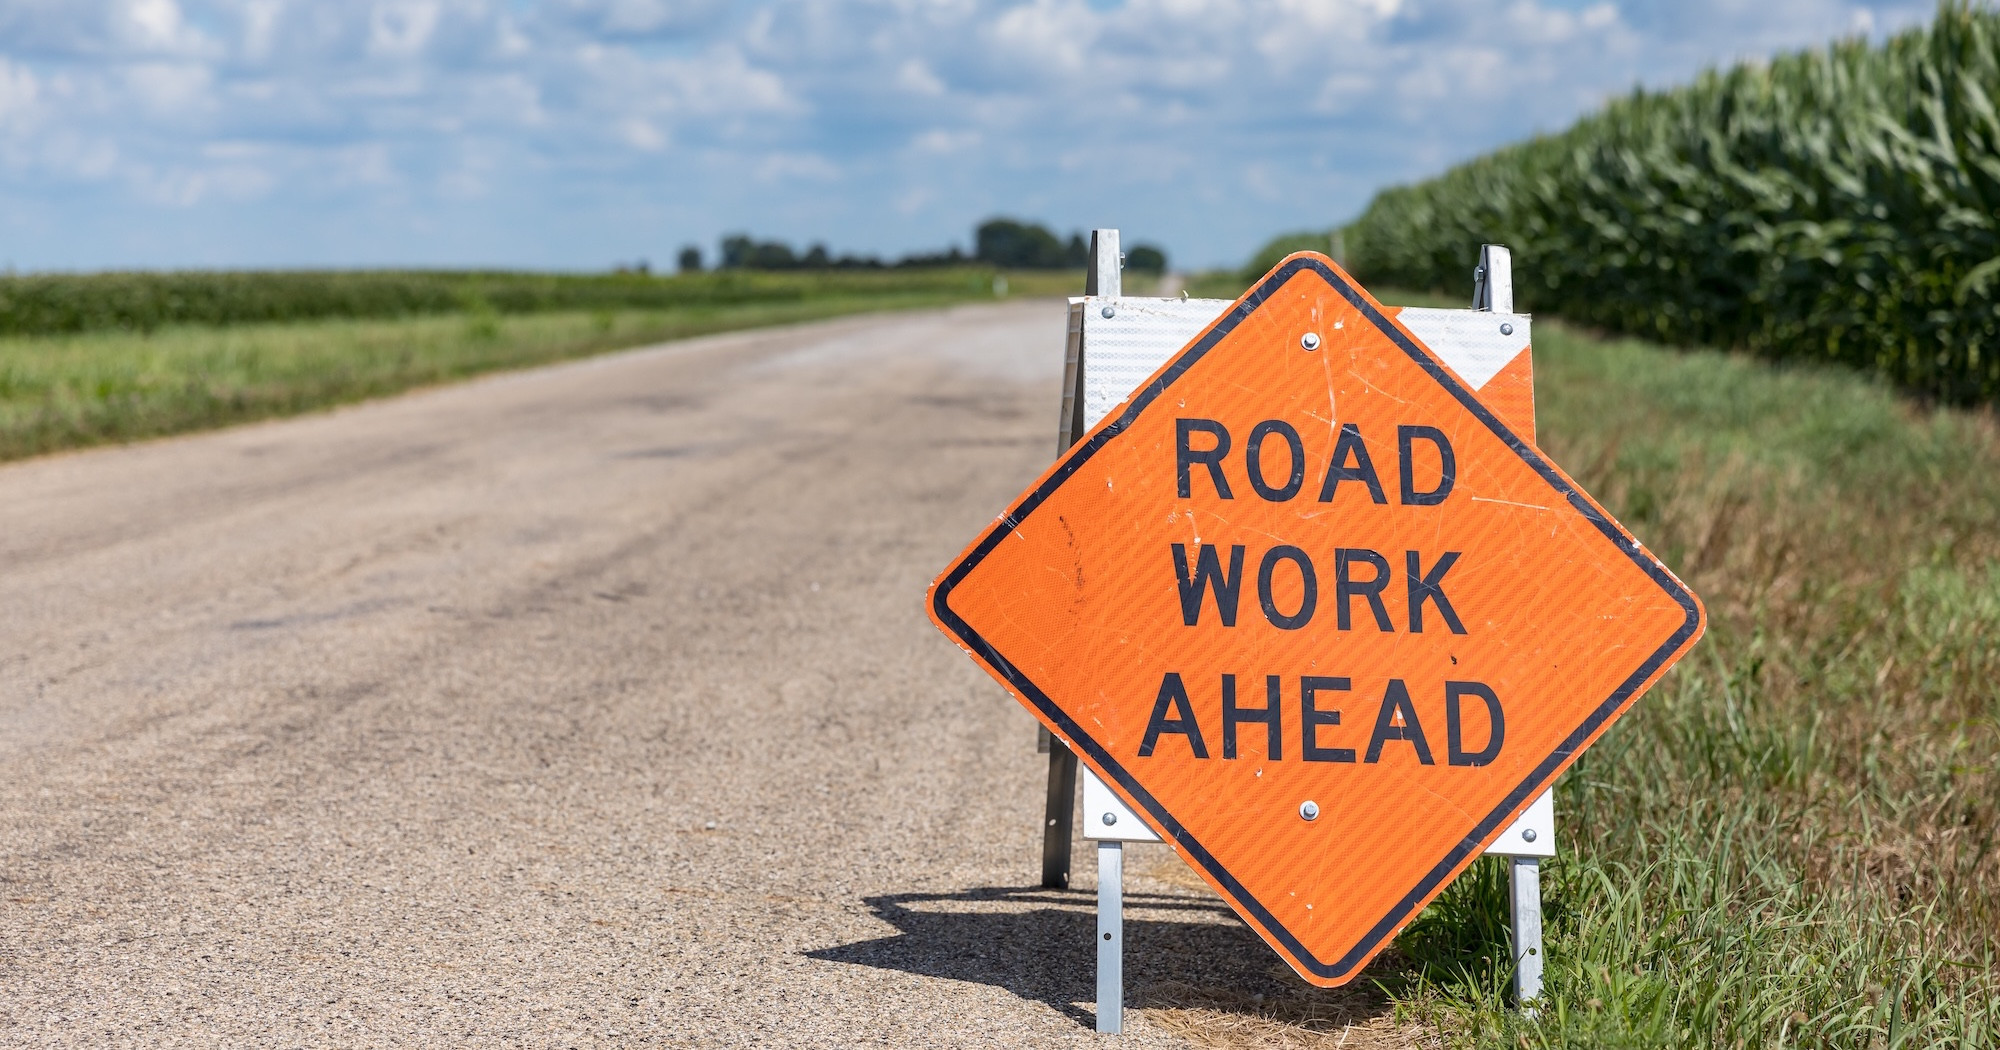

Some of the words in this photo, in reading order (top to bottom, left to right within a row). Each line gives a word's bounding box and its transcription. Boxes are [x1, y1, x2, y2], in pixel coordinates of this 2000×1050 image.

[1175, 418, 1456, 506] ROAD
[1171, 543, 1468, 635] WORK
[1138, 672, 1506, 767] AHEAD
